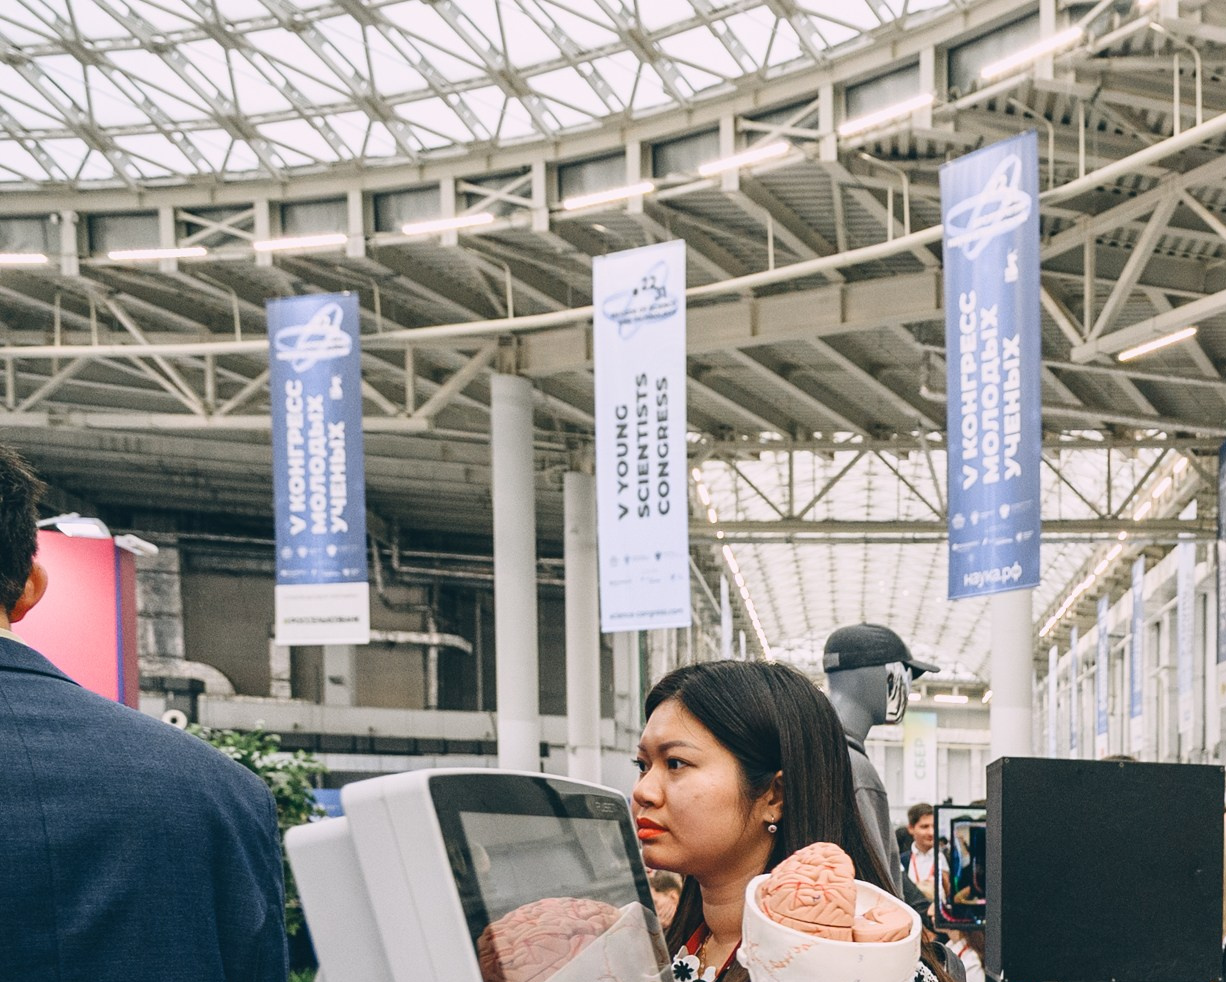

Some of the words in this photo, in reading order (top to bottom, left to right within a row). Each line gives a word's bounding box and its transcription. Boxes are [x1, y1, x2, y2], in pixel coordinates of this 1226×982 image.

[959, 289, 978, 461] КОНГРЕСС
[980, 303, 1001, 486] МОЛОДЫХ
[1003, 332, 1021, 482] УЧЕНЫХ
[285, 379, 306, 512] КОНГРЕСС
[307, 393, 328, 536] МОЛОДЫХ
[328, 420, 349, 535] УЧЕНЫХ
[615, 404, 630, 496] YOUNG
[635, 372, 650, 519] SCIENTISTS
[656, 376, 671, 516] CONGRESS
[961, 465, 978, 491] V
[289, 514, 307, 537] V
[618, 506, 630, 520] V
[963, 560, 1024, 590] наука.рф
